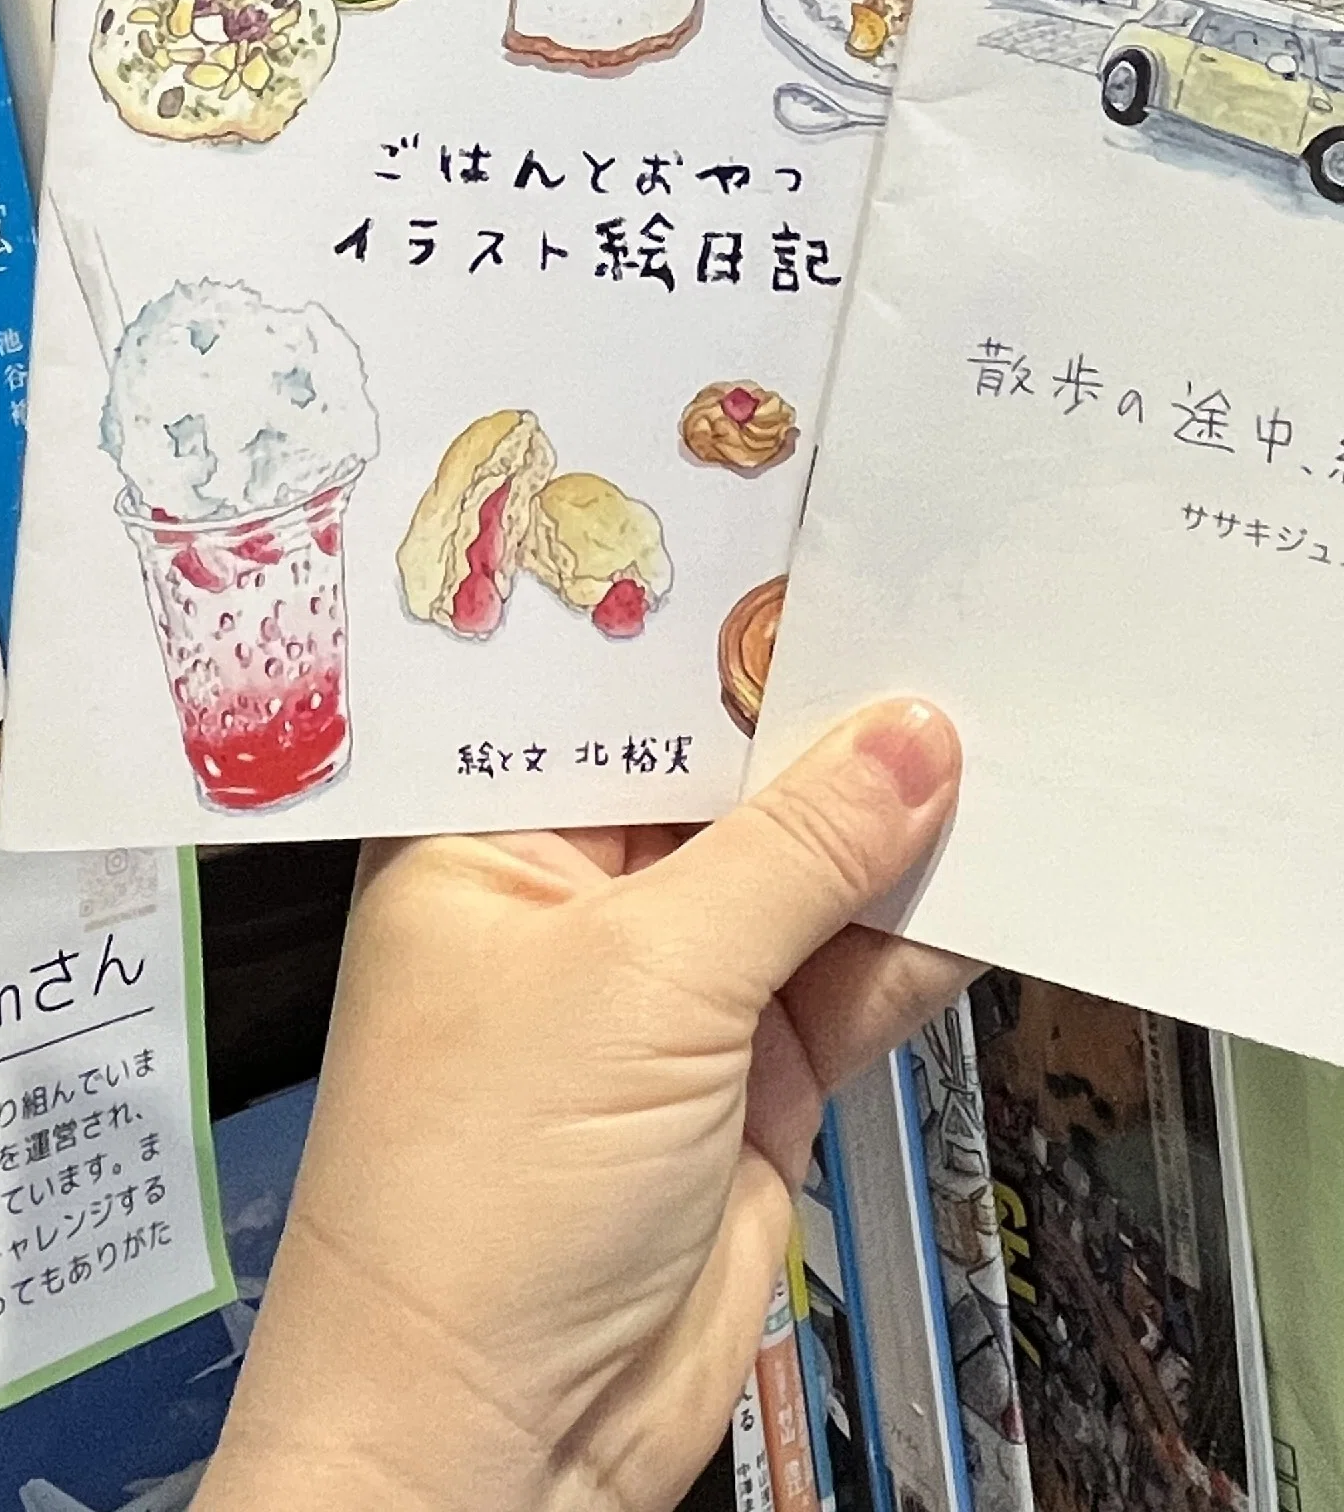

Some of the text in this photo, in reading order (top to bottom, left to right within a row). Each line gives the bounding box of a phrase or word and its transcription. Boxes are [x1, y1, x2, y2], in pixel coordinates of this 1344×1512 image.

[374, 133, 803, 194] ごはんとおやつ
[334, 212, 842, 292] イラスト絵日記
[458, 741, 548, 778] 絵と文
